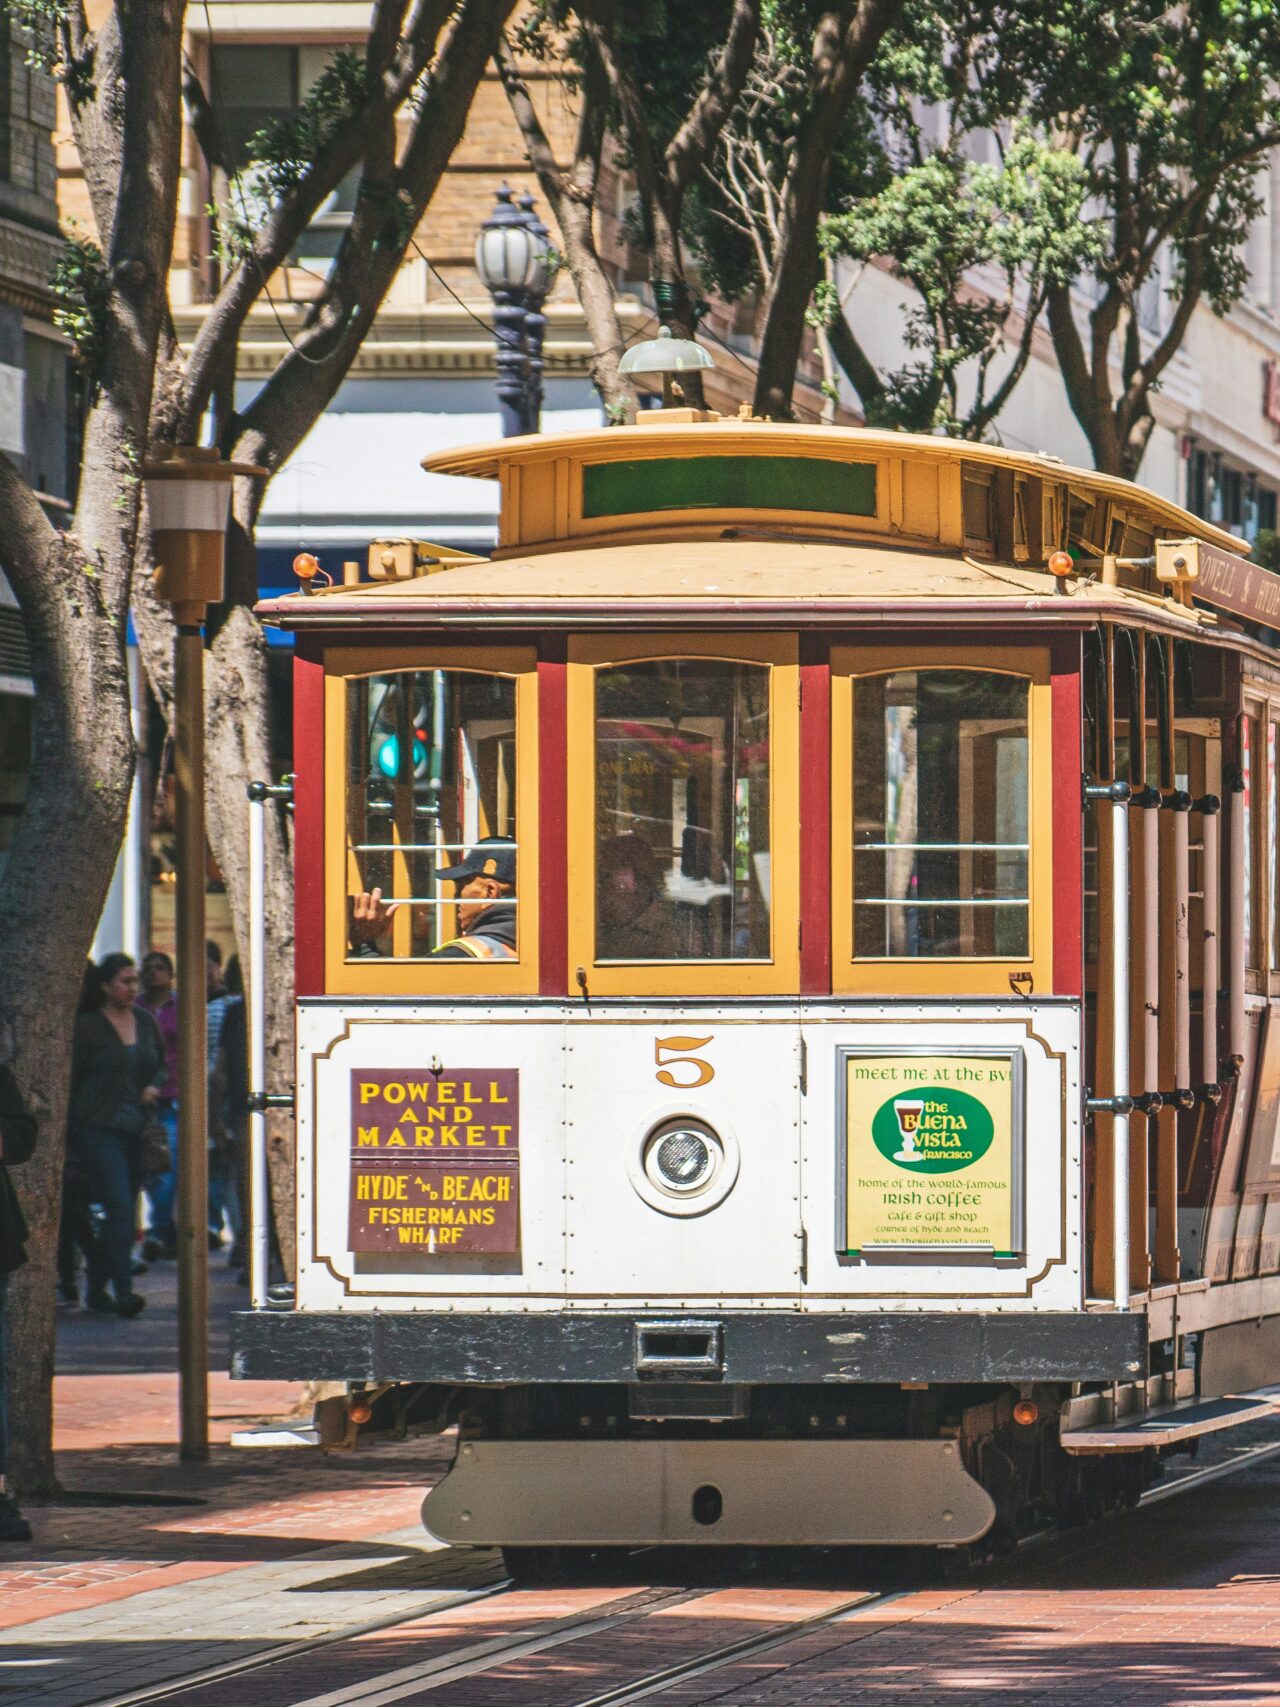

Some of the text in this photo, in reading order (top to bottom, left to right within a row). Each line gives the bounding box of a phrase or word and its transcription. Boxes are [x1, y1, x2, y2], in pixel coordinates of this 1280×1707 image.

[655, 1035, 715, 1088] 5
[855, 1067, 898, 1080] meet
[904, 1067, 928, 1080] me
[933, 1067, 950, 1081] at
[956, 1067, 984, 1081] the
[360, 1082, 508, 1104] POWELL
[399, 1106, 473, 1123] AND
[925, 1101, 949, 1113] the
[357, 1125, 512, 1147] MARKET
[356, 1175, 510, 1201] HYDE AND BEACH
[858, 1178, 1007, 1190] home of the world-famous
[926, 1191, 982, 1208] coffee
[368, 1207, 495, 1225] FISHERMANS
[949, 1211, 977, 1223] shop
[398, 1226, 464, 1244] WHARF
